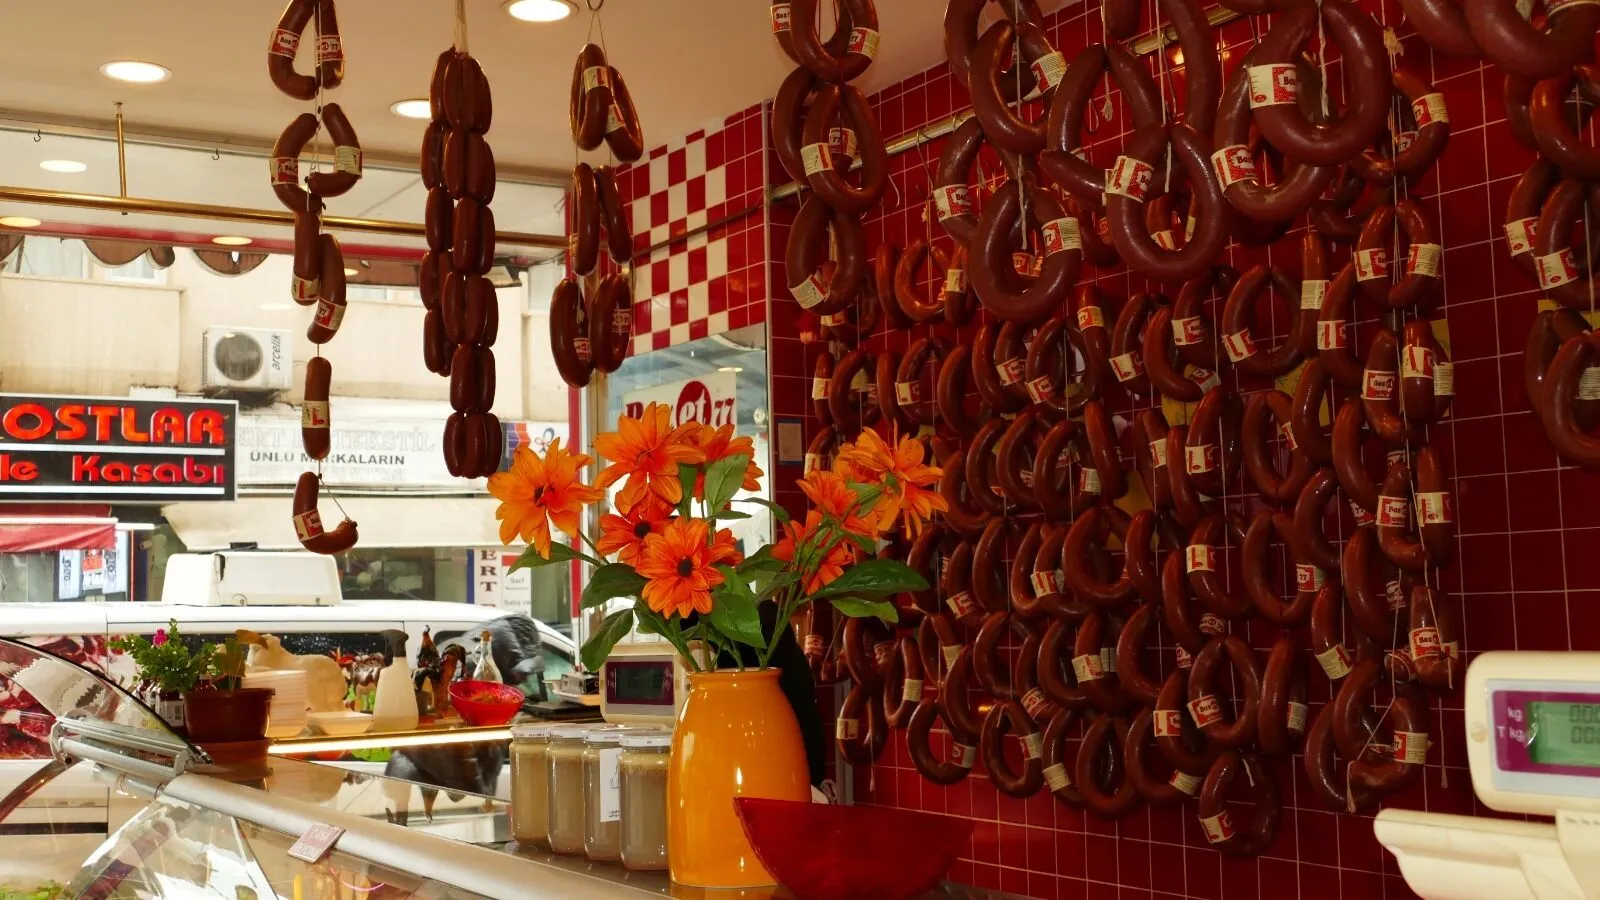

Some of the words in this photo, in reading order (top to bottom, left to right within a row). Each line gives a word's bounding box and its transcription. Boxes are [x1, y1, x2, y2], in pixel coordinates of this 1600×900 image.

[0, 403, 225, 444] OSTLAR
[714, 397, 736, 427] 77
[72, 454, 224, 484] Kasabı
[250, 449, 295, 462] ÜNLÜ
[300, 452, 405, 465] MKALARIN
[1507, 706, 1523, 722] kg
